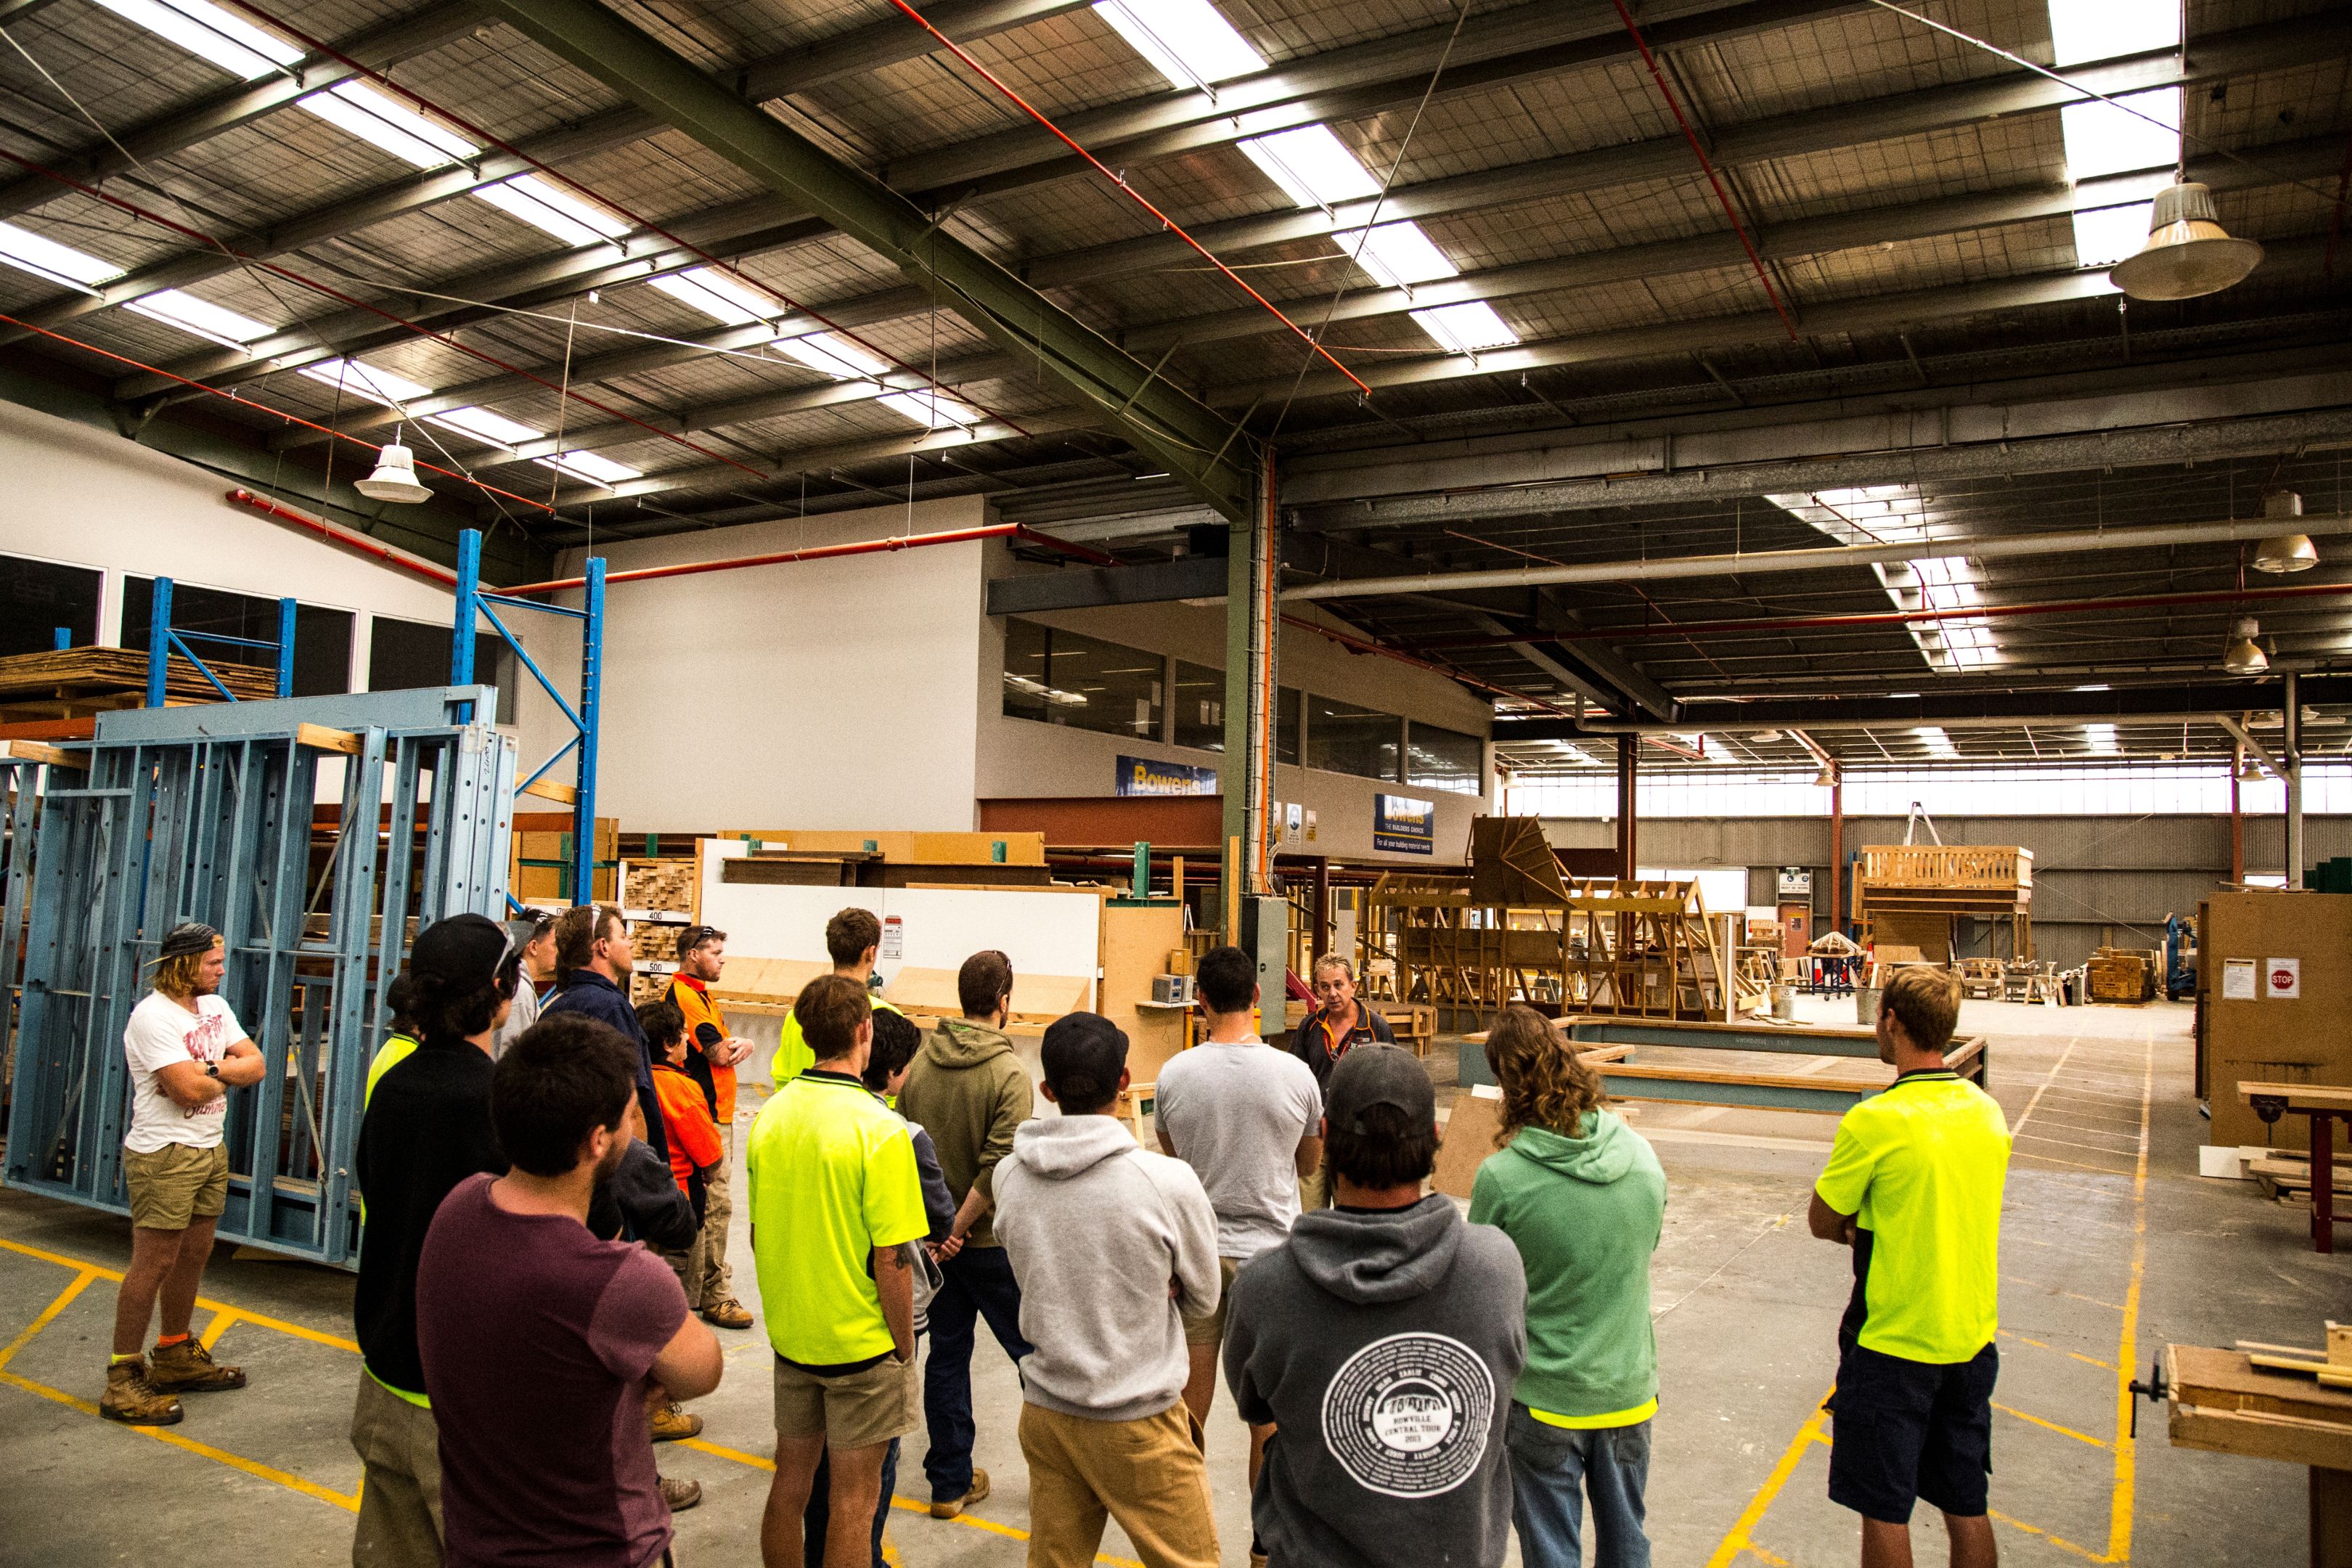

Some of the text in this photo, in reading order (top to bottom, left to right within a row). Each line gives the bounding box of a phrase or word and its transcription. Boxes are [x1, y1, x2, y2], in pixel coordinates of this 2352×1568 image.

[1135, 765, 1201, 795] Bowens
[1396, 841, 1408, 850] building
[649, 963, 662, 971] 500
[2272, 975, 2293, 984] STOP
[1394, 1415, 1432, 1424] ROWVILLE
[1385, 1426, 1418, 1436] CENTRAL
